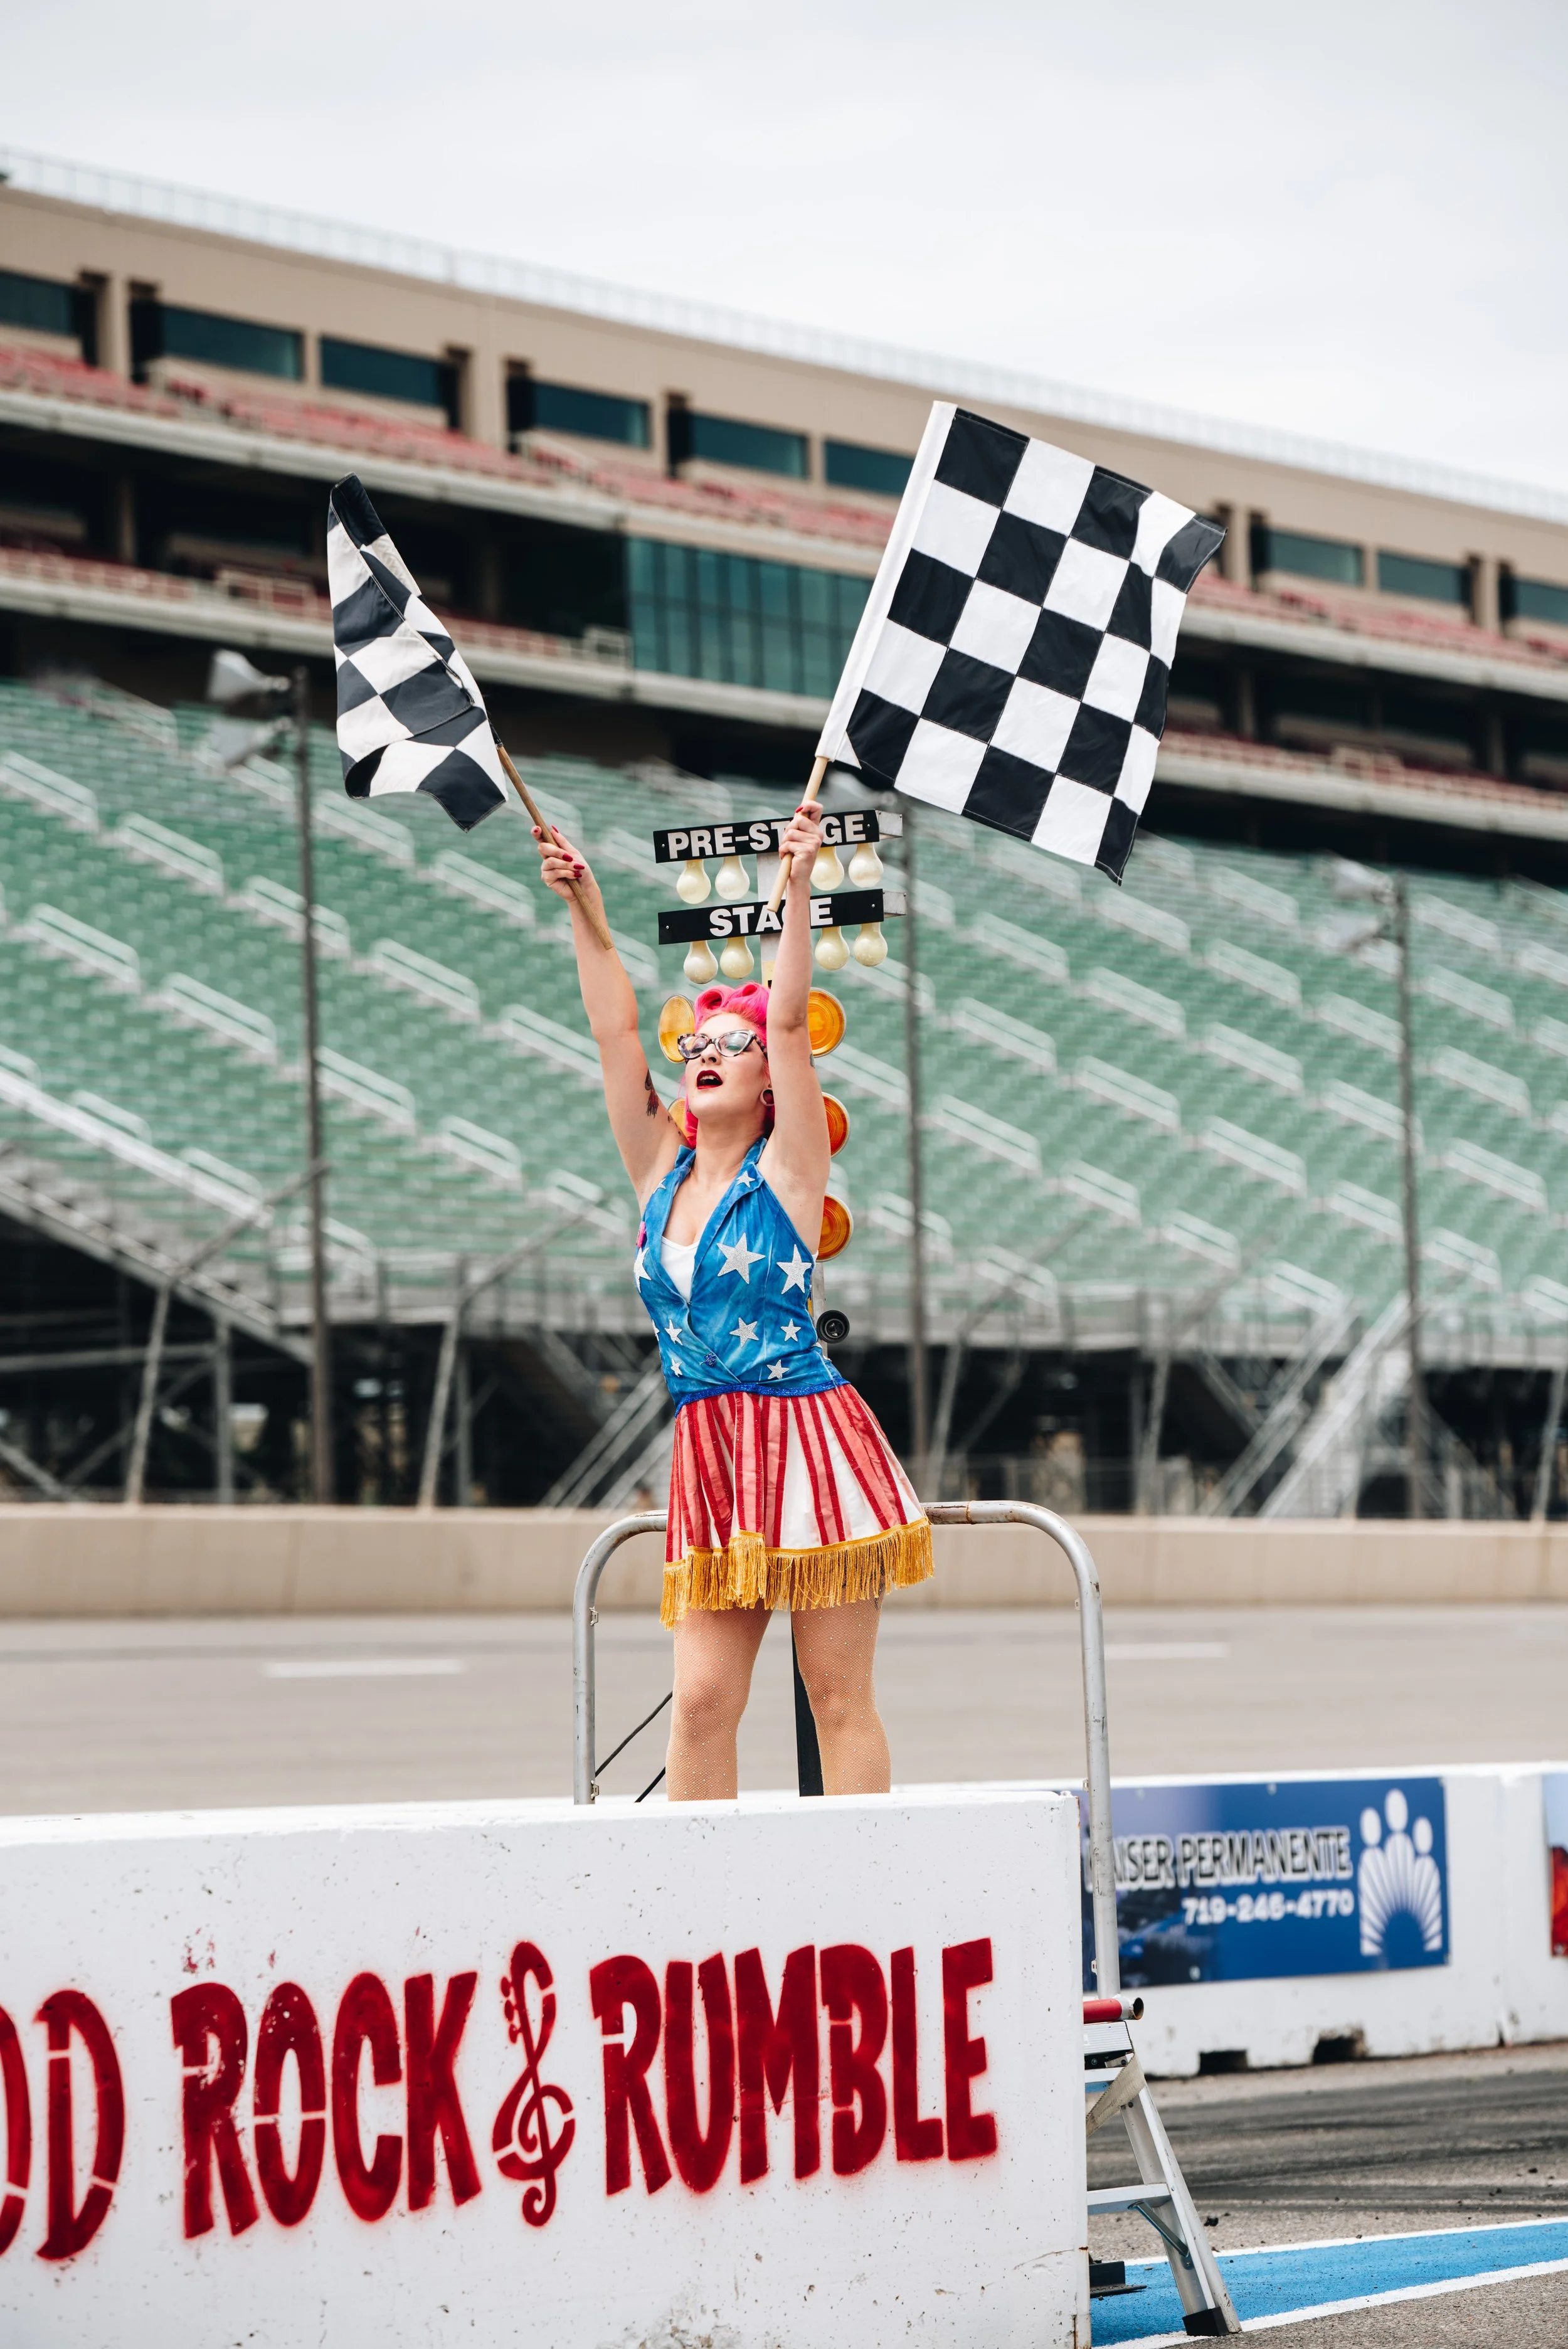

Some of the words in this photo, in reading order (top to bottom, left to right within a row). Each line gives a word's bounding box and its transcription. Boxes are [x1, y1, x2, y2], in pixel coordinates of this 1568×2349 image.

[667, 814, 866, 859] PRE-STGE
[709, 897, 833, 936] STAE
[1177, 1825, 1353, 1889] PERMANENTE
[171, 1971, 482, 2240] ROCK
[589, 1937, 998, 2197] RUMBLE
